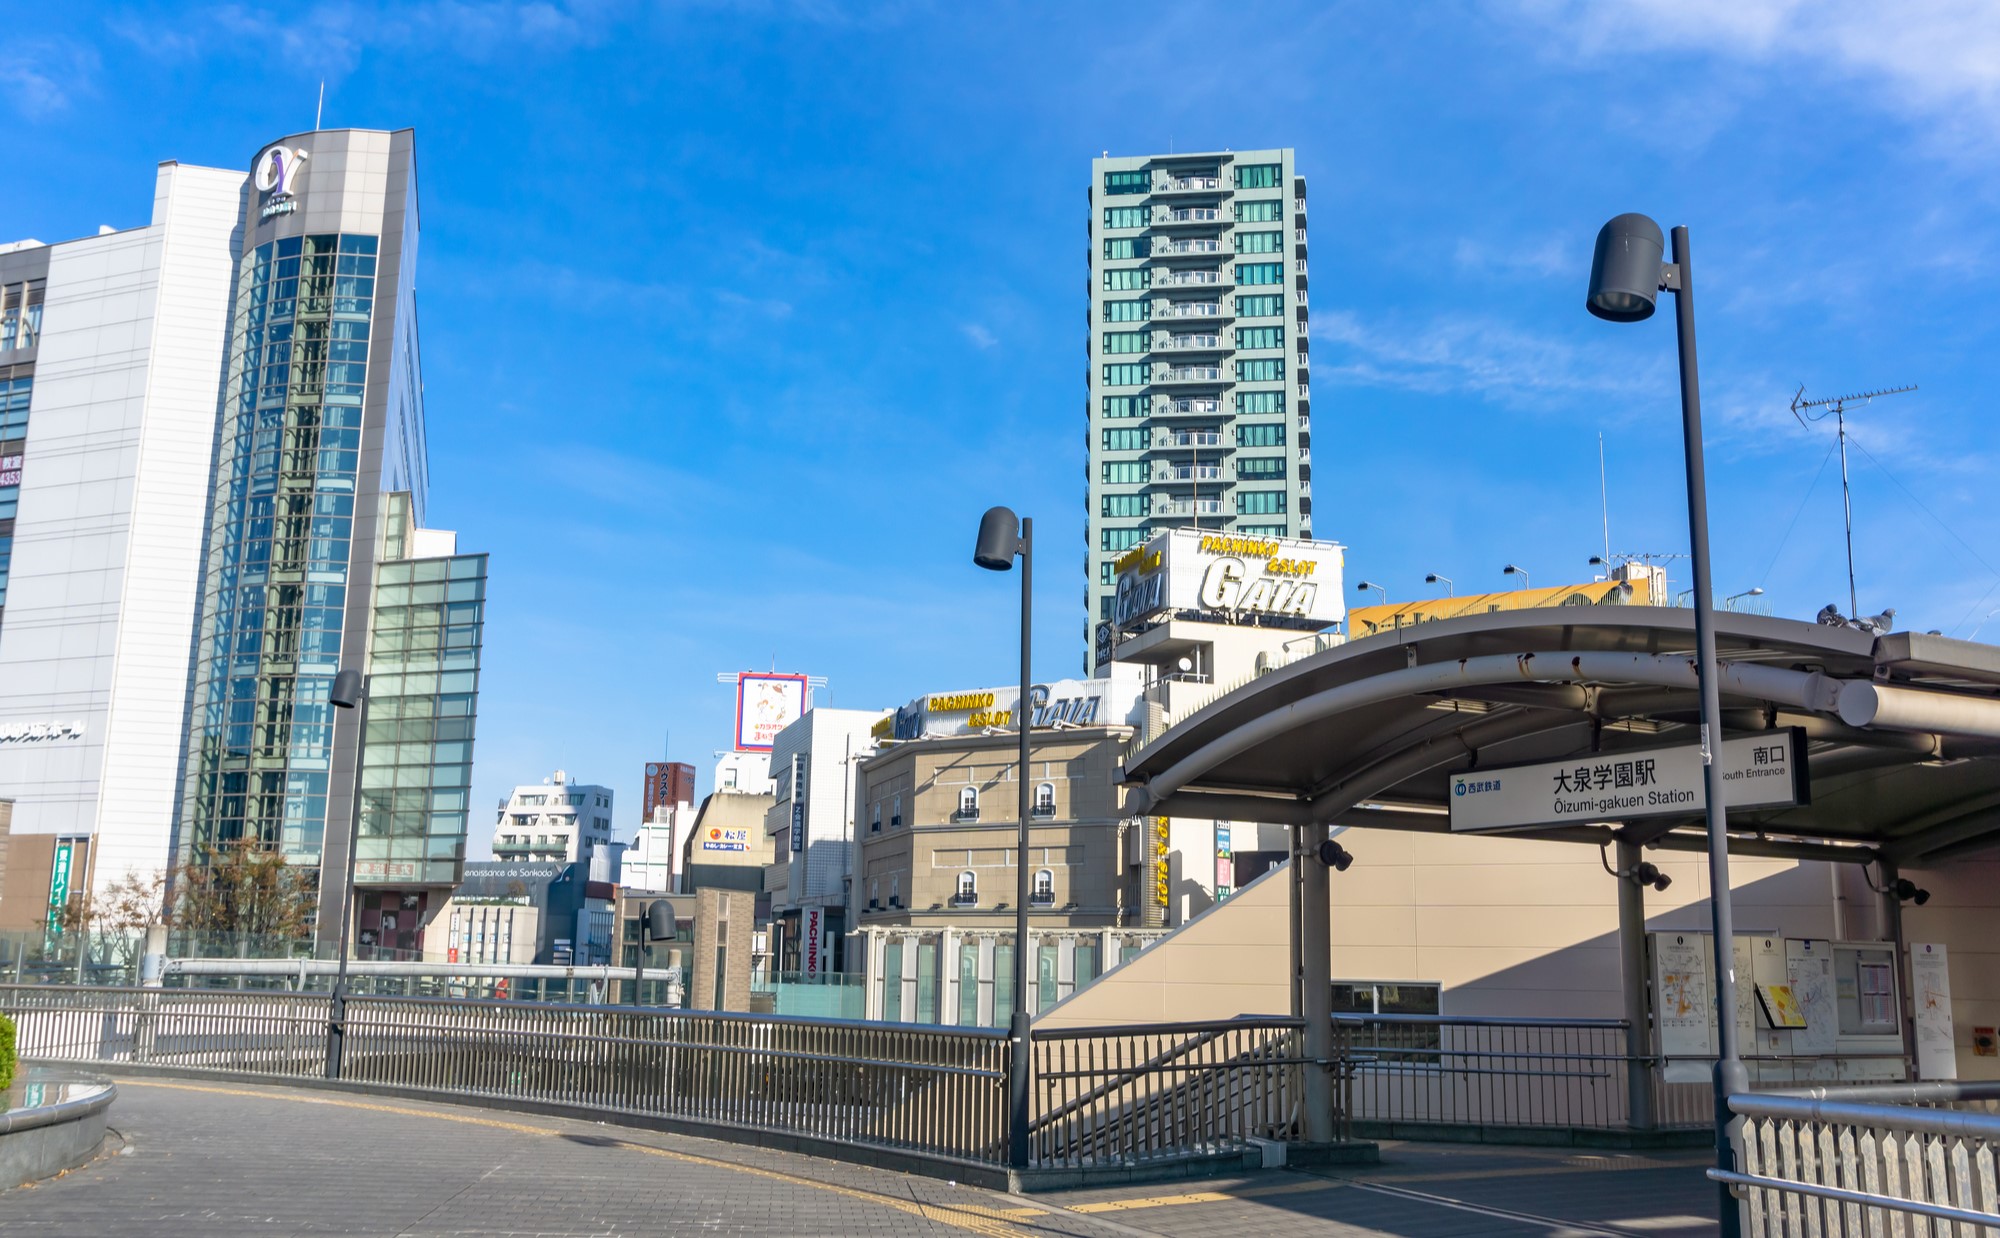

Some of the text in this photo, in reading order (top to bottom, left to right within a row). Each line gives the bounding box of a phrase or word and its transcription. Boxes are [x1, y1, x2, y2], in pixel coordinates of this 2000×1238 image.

[1201, 535, 1280, 556] PACHINKO
[1267, 556, 1317, 576] &SLOT
[1201, 556, 1318, 617] GAIA
[928, 692, 995, 713] PACHINKO
[967, 710, 1013, 728] &SLOT
[1753, 745, 1785, 765] 南口
[1553, 758, 1657, 795] 大泉学園駅
[1722, 766, 1786, 781] outh Entrance
[1468, 779, 1501, 794] 西武鉄道
[1553, 788, 1695, 815] Ōizumi-gakuen Station
[725, 829, 746, 840] 松屋
[507, 868, 517, 877] de
